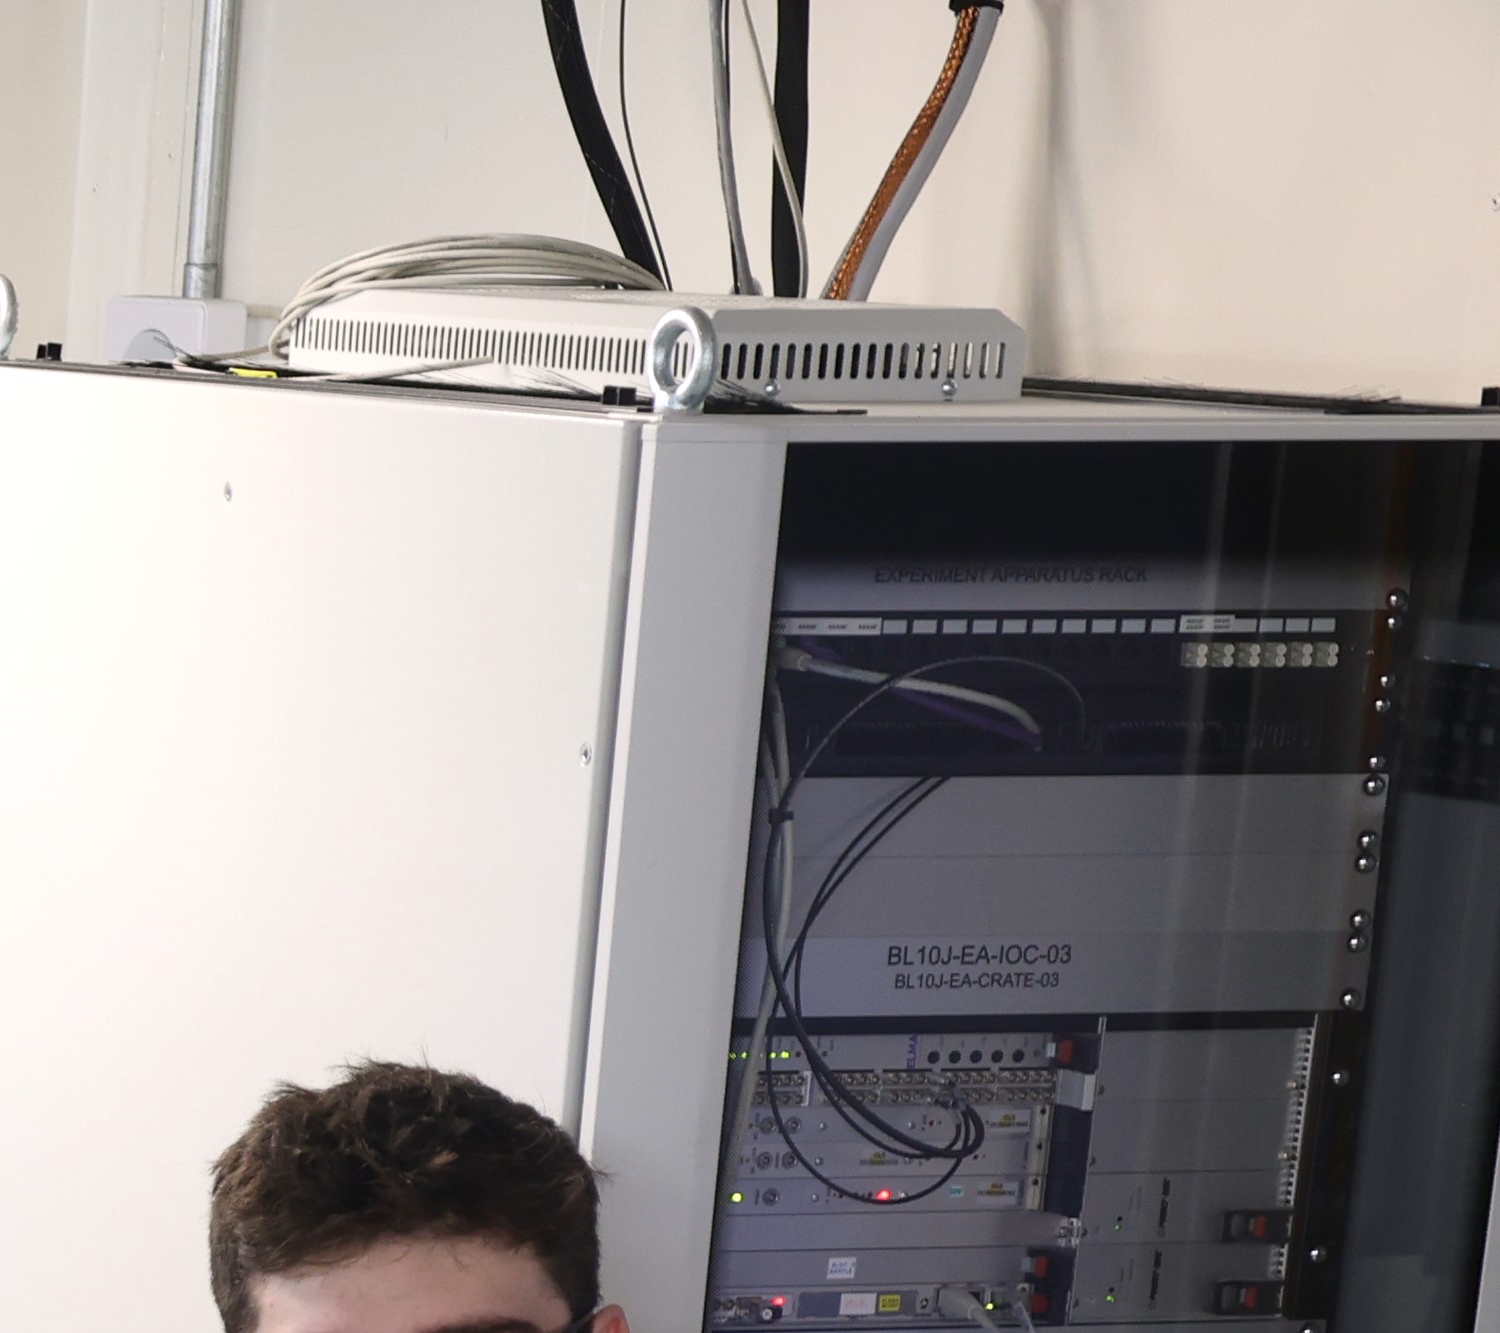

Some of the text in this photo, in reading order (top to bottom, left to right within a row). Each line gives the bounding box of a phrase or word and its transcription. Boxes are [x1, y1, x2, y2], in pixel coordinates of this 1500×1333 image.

[875, 565, 1148, 583] EXPERIMENT APPARATUS RACK
[887, 944, 1072, 966] BL10J-EA-IOC-03
[894, 972, 1060, 989] BL10J-EA-CRATE-03
